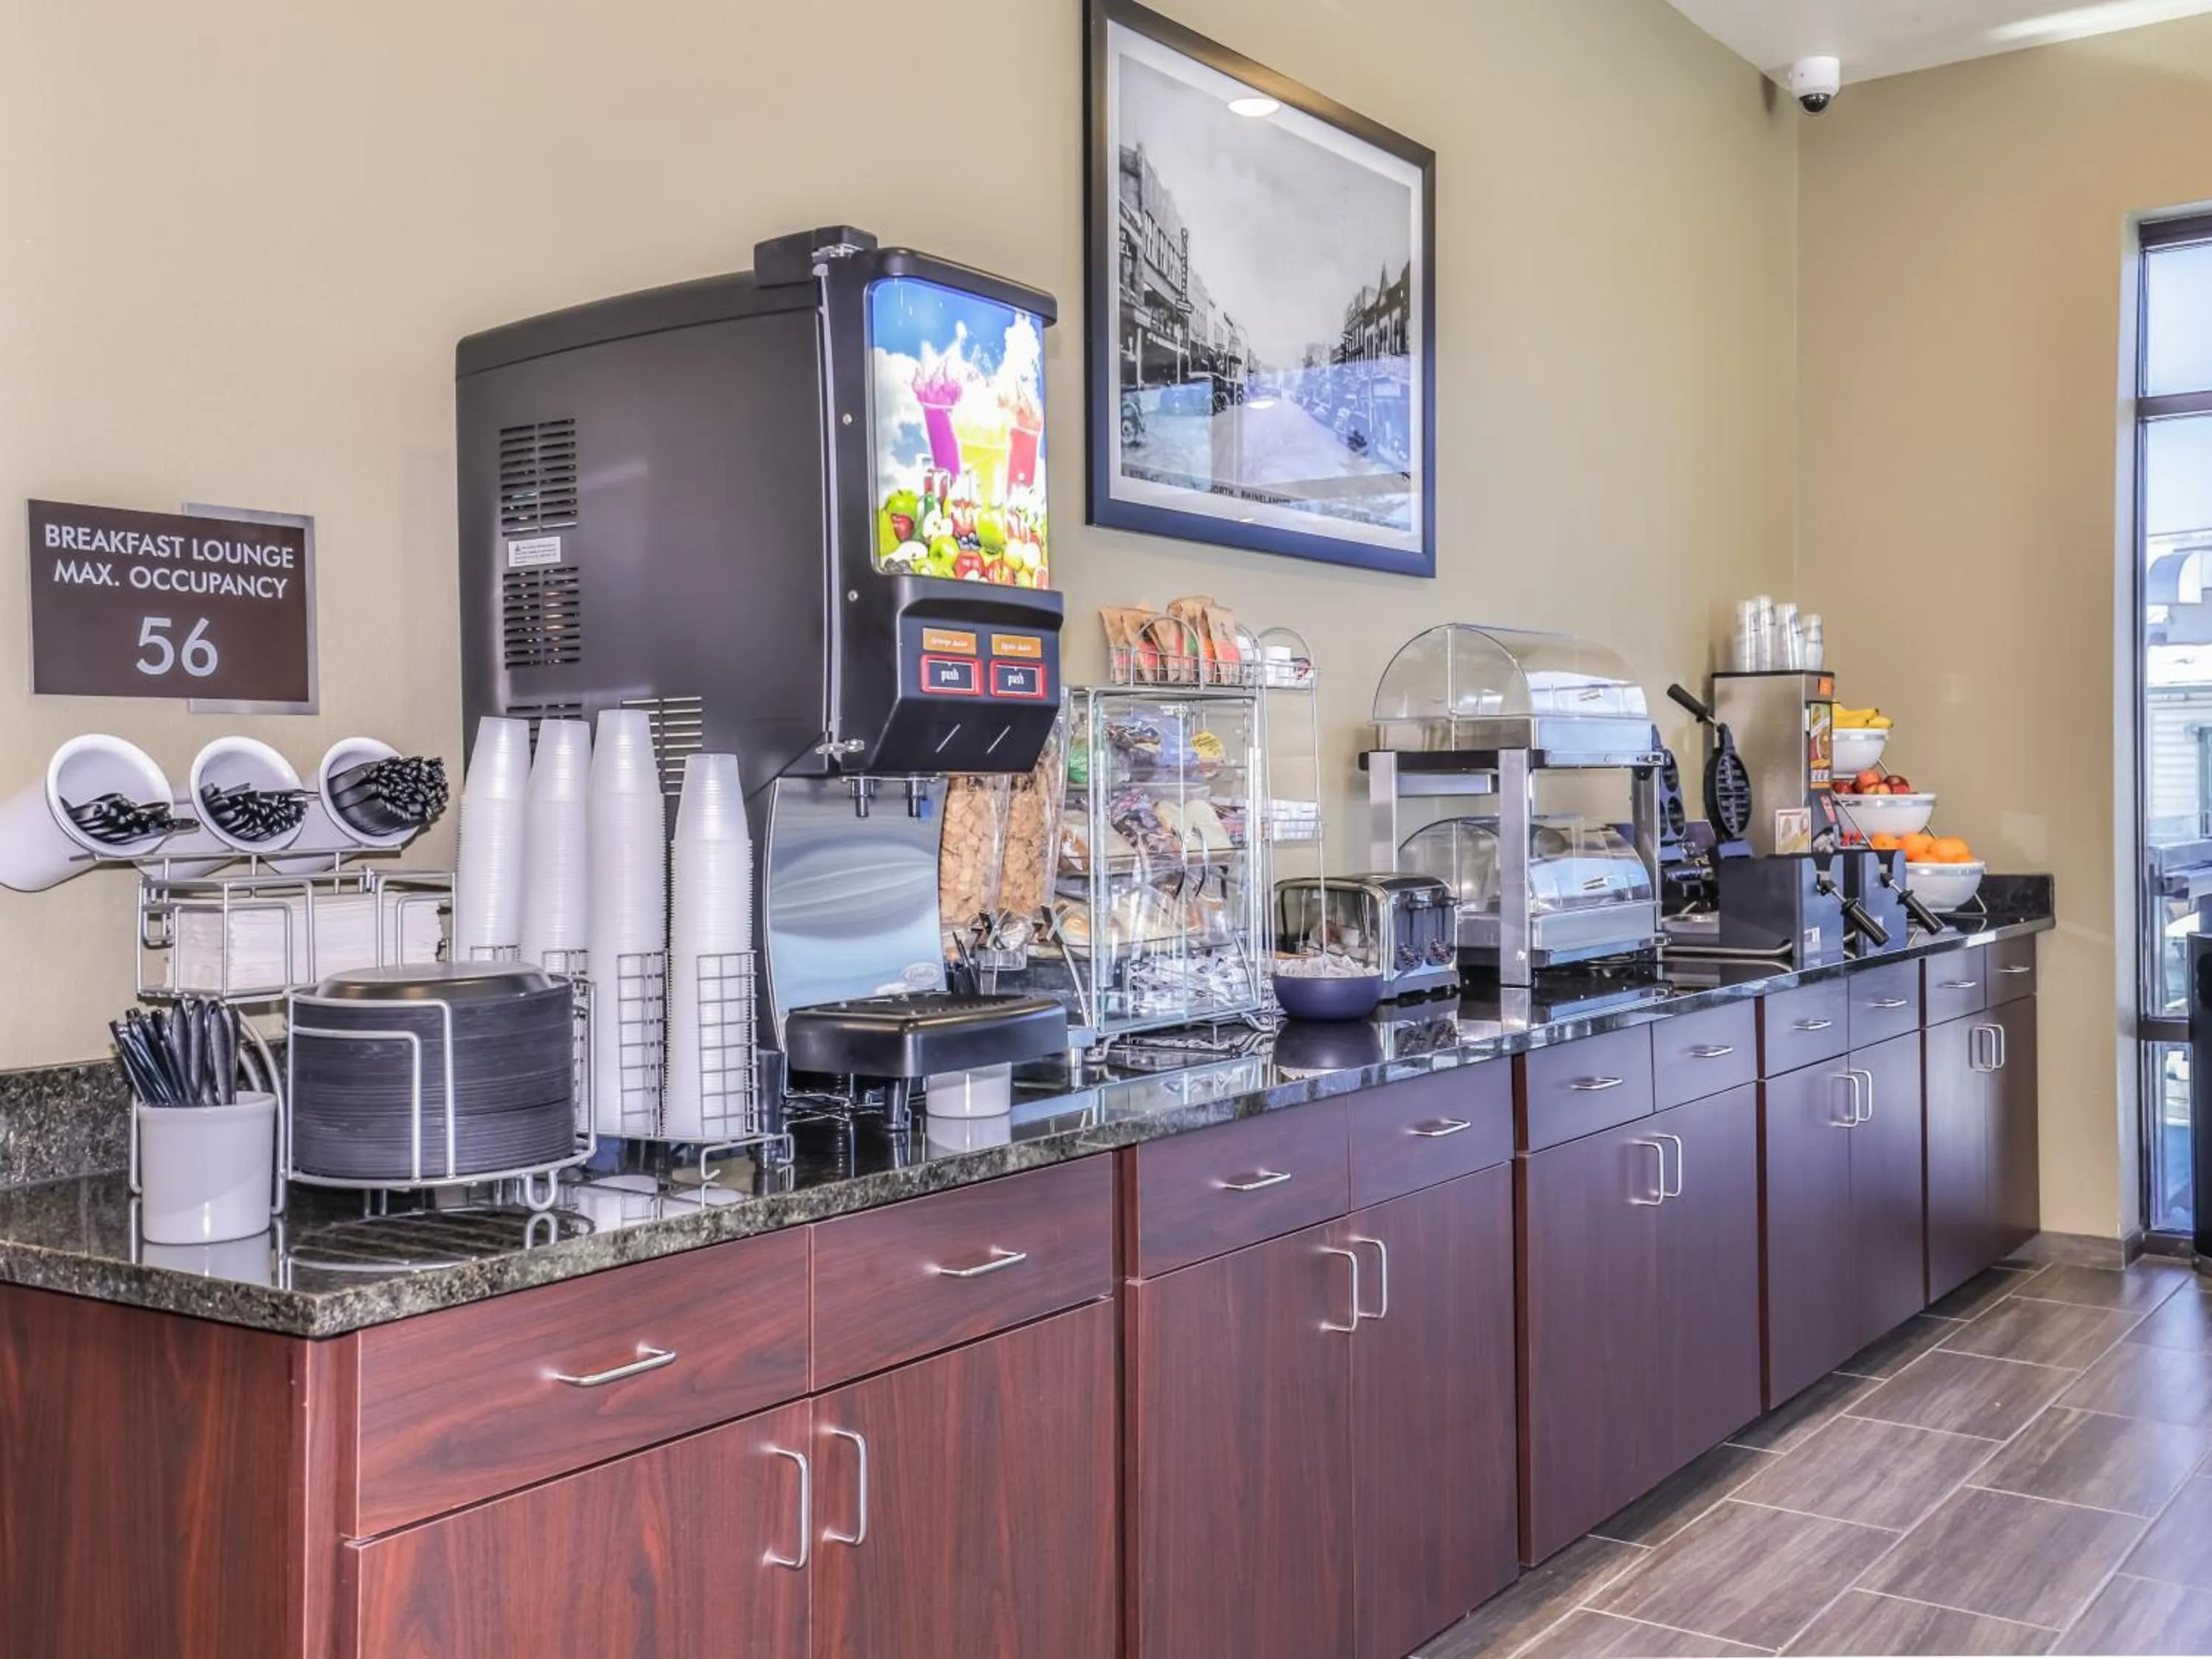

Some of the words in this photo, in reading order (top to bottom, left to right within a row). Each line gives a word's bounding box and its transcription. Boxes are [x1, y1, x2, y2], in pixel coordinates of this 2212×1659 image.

[44, 523, 184, 560] BREAKFAST
[192, 538, 295, 568] LOUNGE
[53, 560, 120, 588] MAX.
[129, 566, 288, 599] OCCUPANCY
[136, 616, 218, 677] 56
[941, 667, 959, 684] push
[1008, 672, 1024, 687] push
